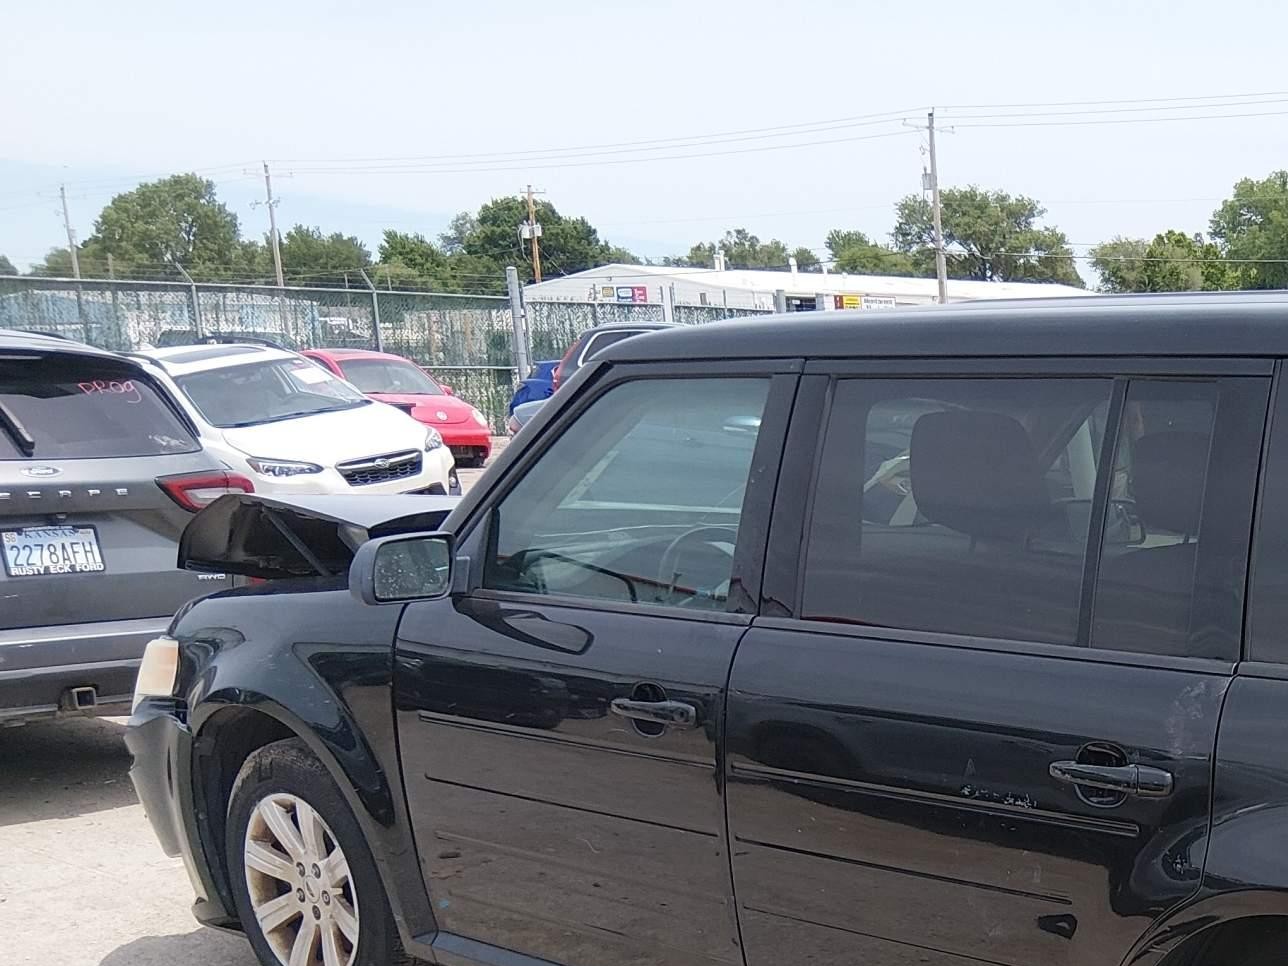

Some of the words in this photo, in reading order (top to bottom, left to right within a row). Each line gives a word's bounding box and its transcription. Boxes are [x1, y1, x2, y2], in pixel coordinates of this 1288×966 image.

[24, 530, 76, 539] KANSAS
[10, 541, 97, 567] 2278AFH
[11, 565, 45, 576] RUSTY
[49, 563, 73, 574] ECK
[76, 562, 105, 572] FORD
